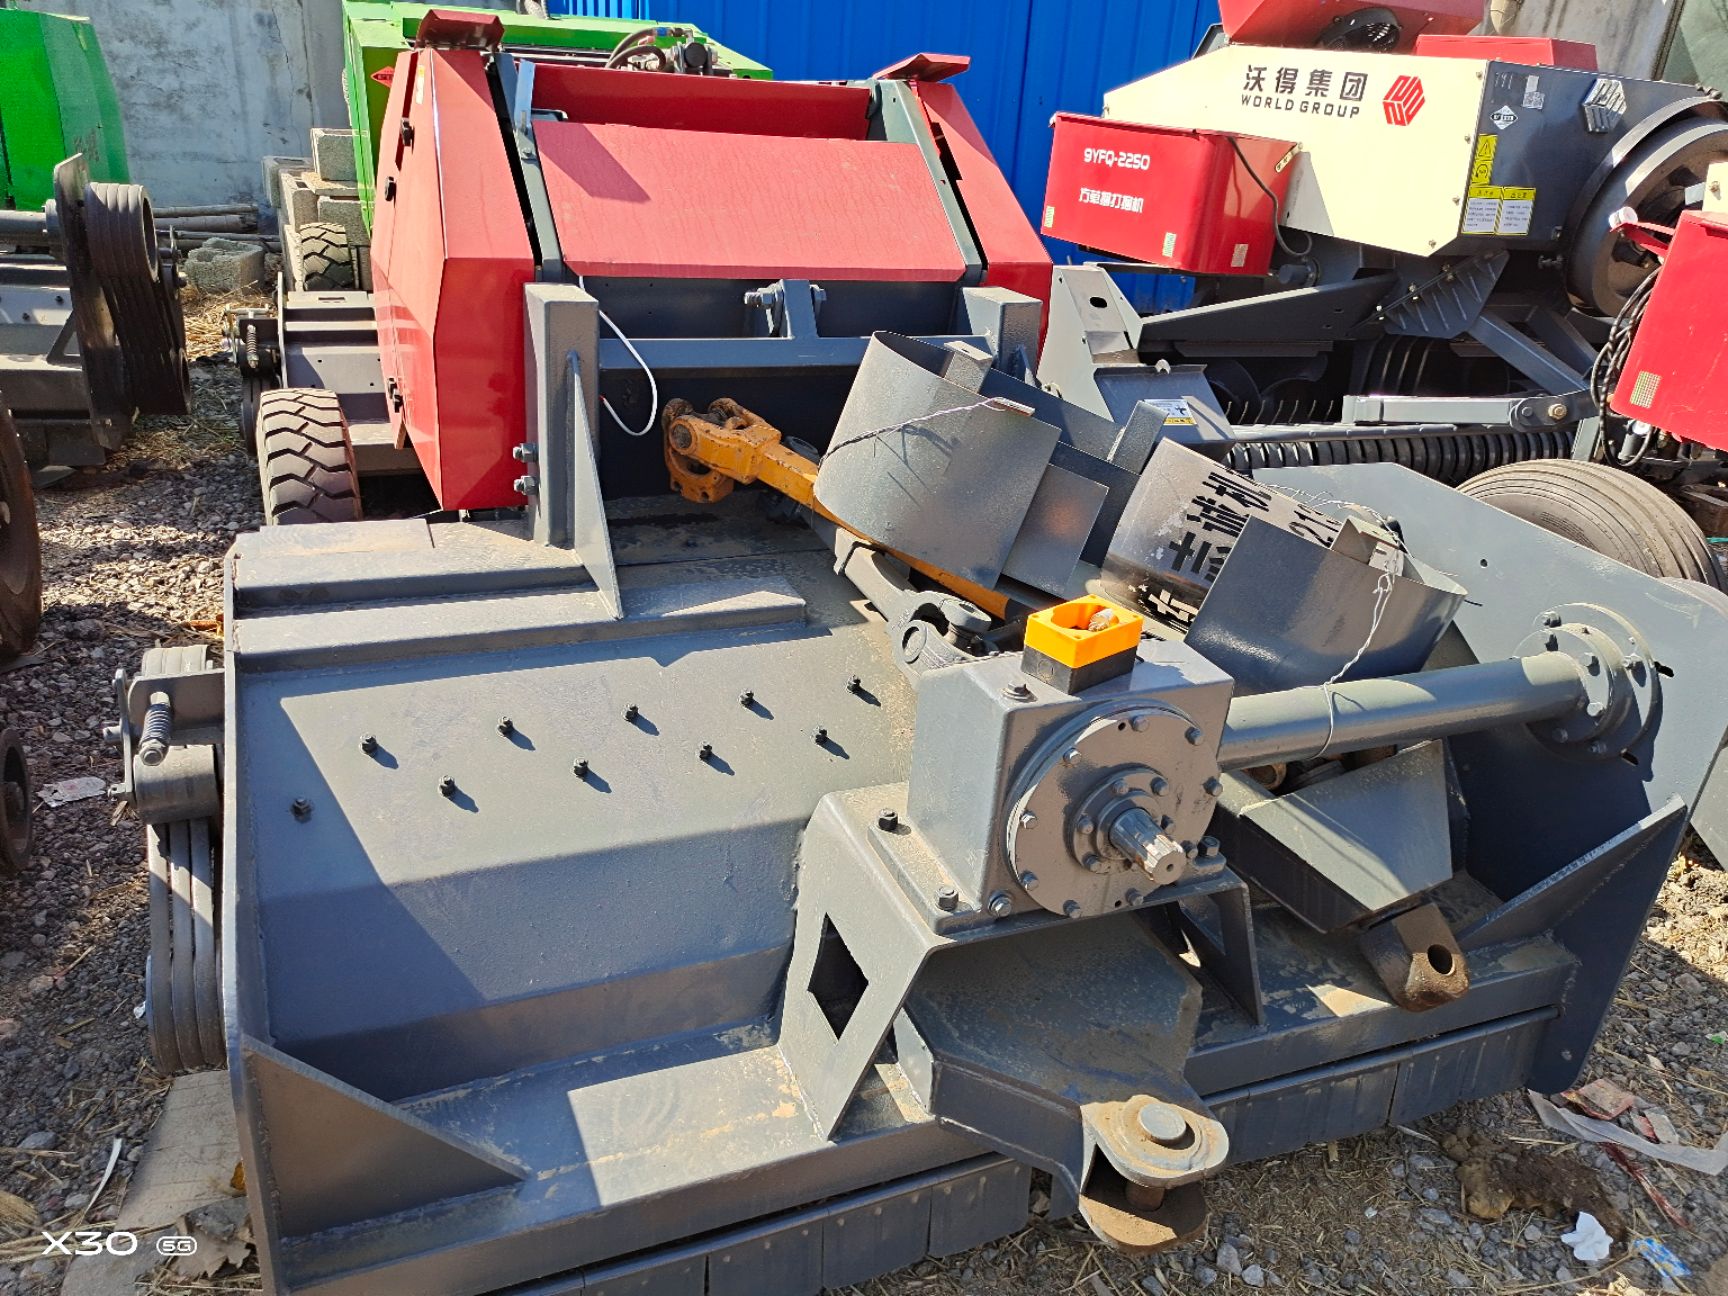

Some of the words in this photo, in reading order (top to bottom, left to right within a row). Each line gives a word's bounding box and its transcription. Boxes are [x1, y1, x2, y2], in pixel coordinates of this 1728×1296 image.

[1243, 64, 1368, 102] 沃得集团
[1241, 94, 1294, 111] WORLD
[1299, 100, 1360, 118] GROUP
[1083, 147, 1151, 171] 9YFQ-2250
